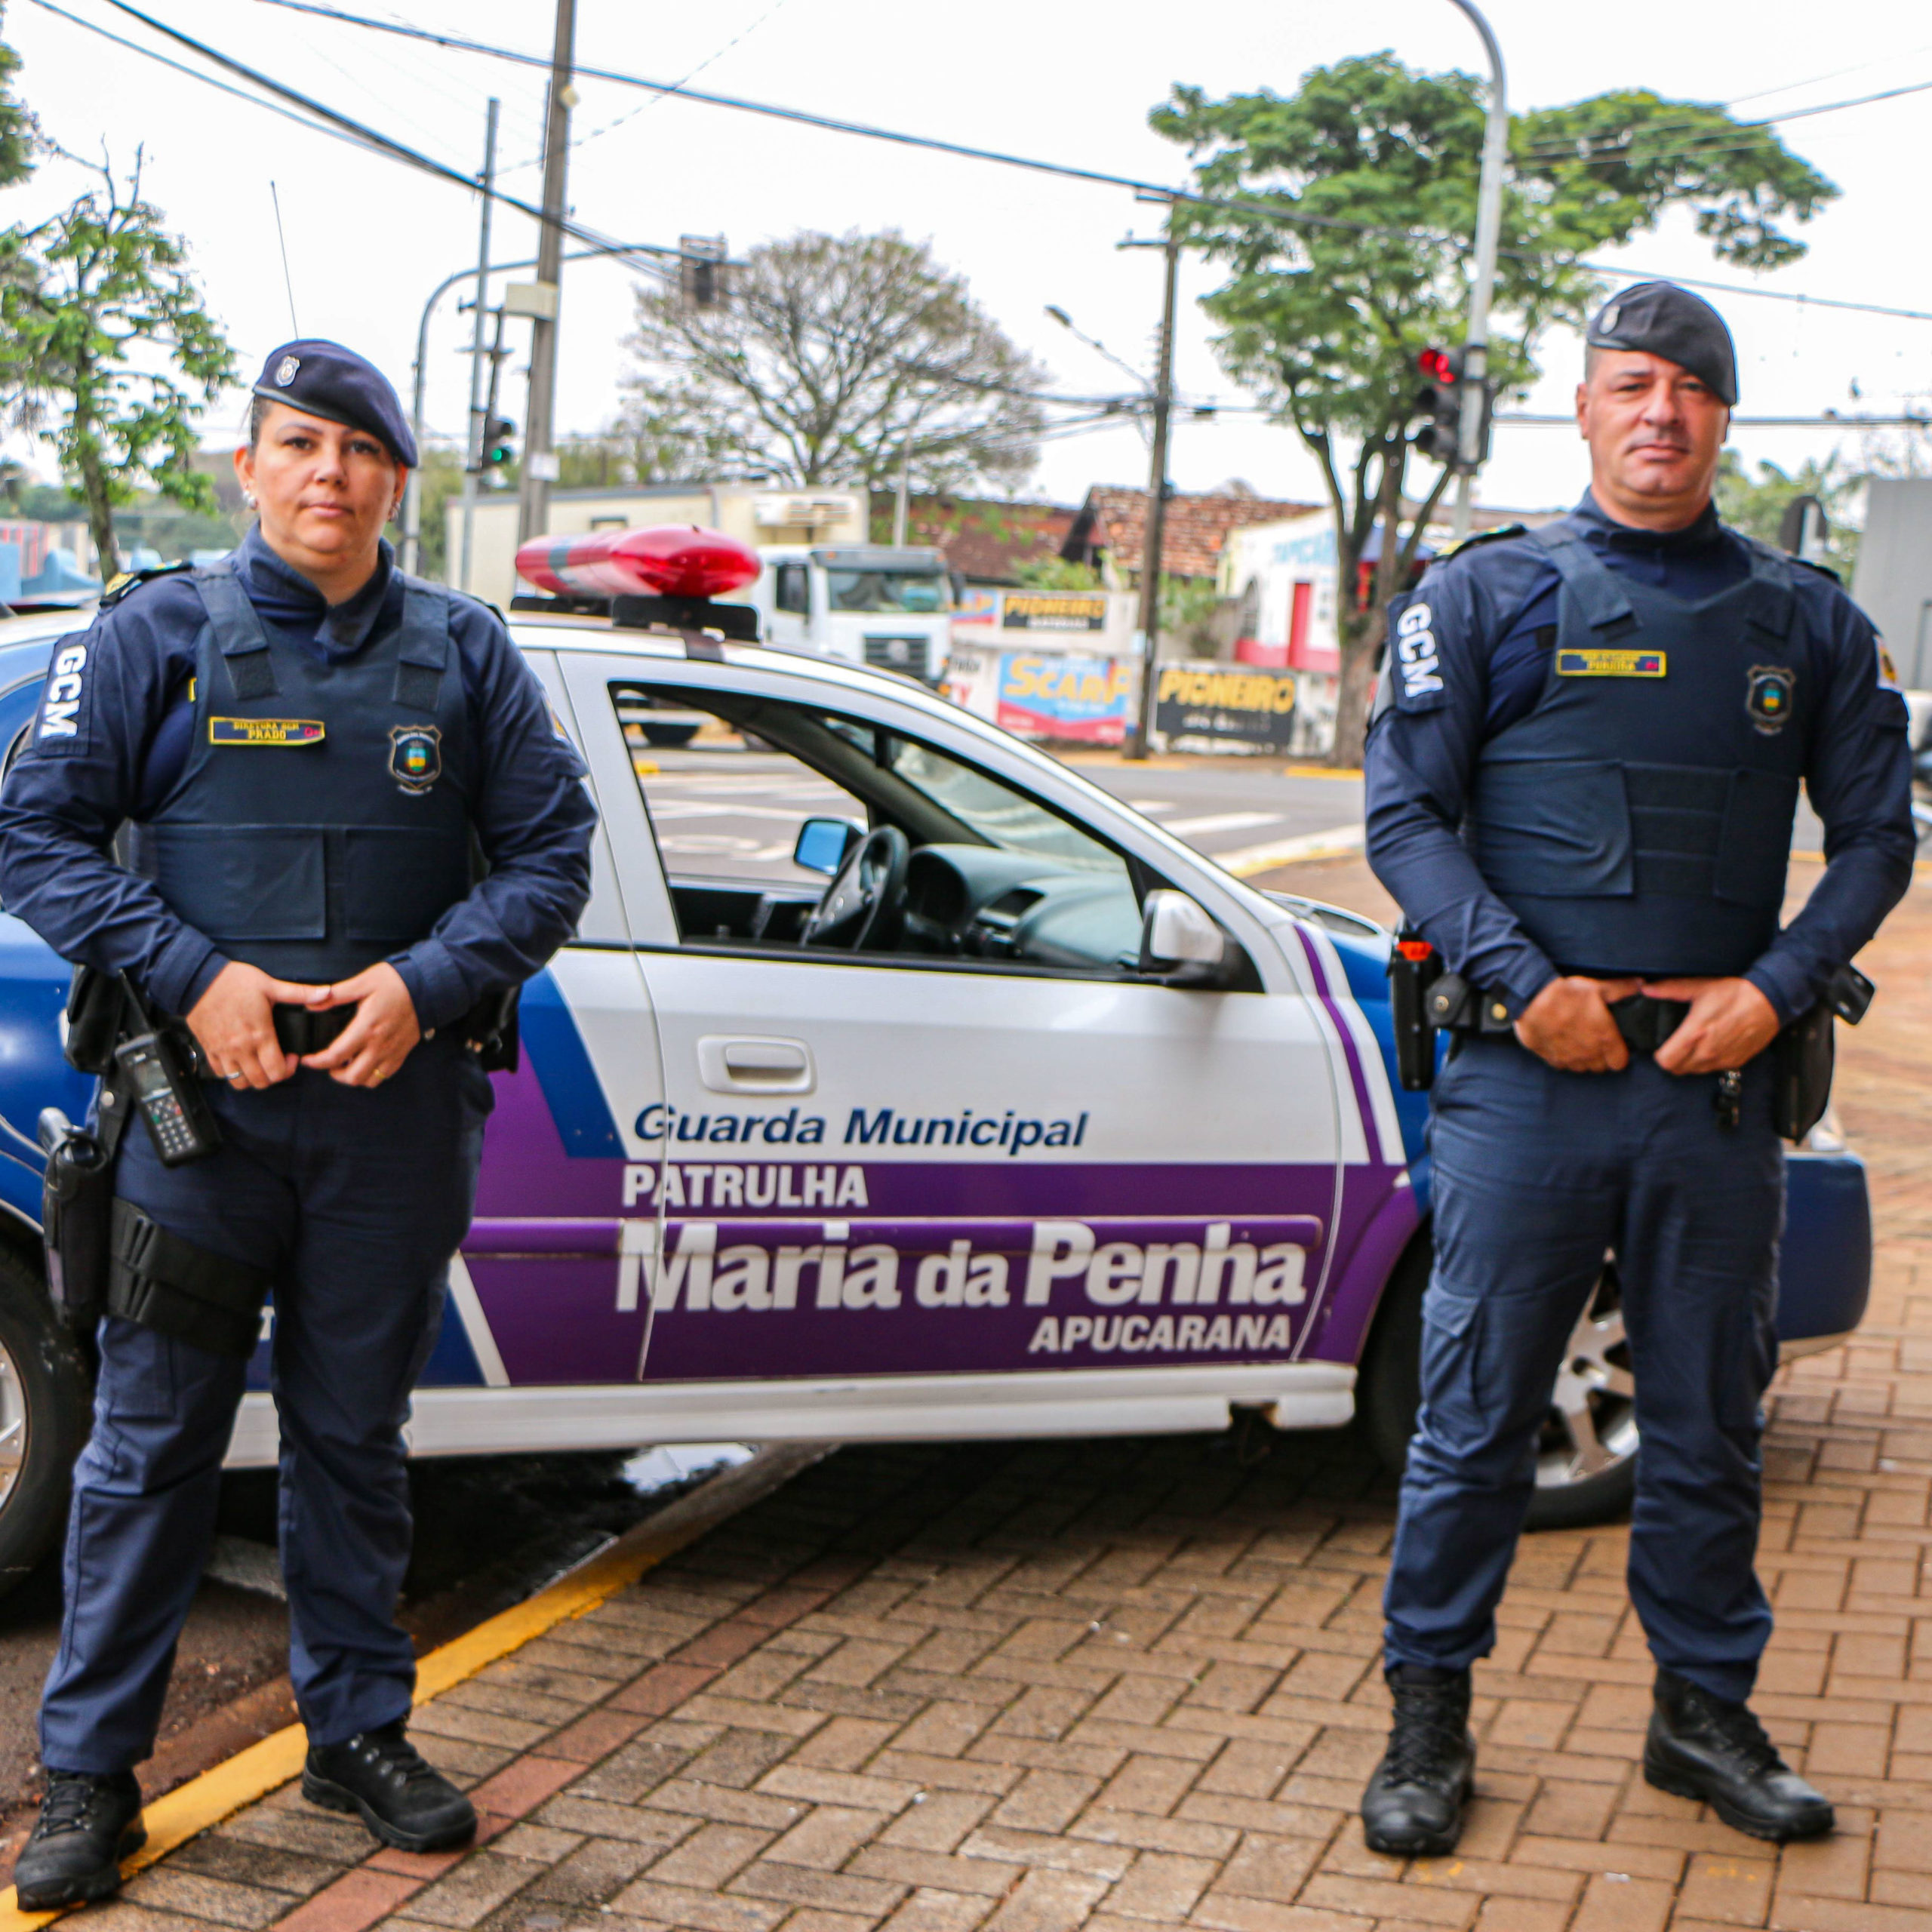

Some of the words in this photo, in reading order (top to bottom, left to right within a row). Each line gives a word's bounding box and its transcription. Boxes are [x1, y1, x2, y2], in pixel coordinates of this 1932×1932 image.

[1005, 597, 1105, 617] PIONEIRO
[1397, 602, 1444, 698] GCM
[39, 645, 88, 739] GCM
[1158, 669, 1296, 714] PIONEIRO
[248, 730, 287, 740] PRADO
[634, 1103, 826, 1144] Guarda
[843, 1107, 1089, 1156] Municipal
[622, 1164, 869, 1207] PATRULHA
[616, 1220, 902, 1312] Maria
[915, 1239, 1011, 1309] da
[1023, 1220, 1307, 1307] Penha
[1027, 1314, 1291, 1353] APUCARANA
